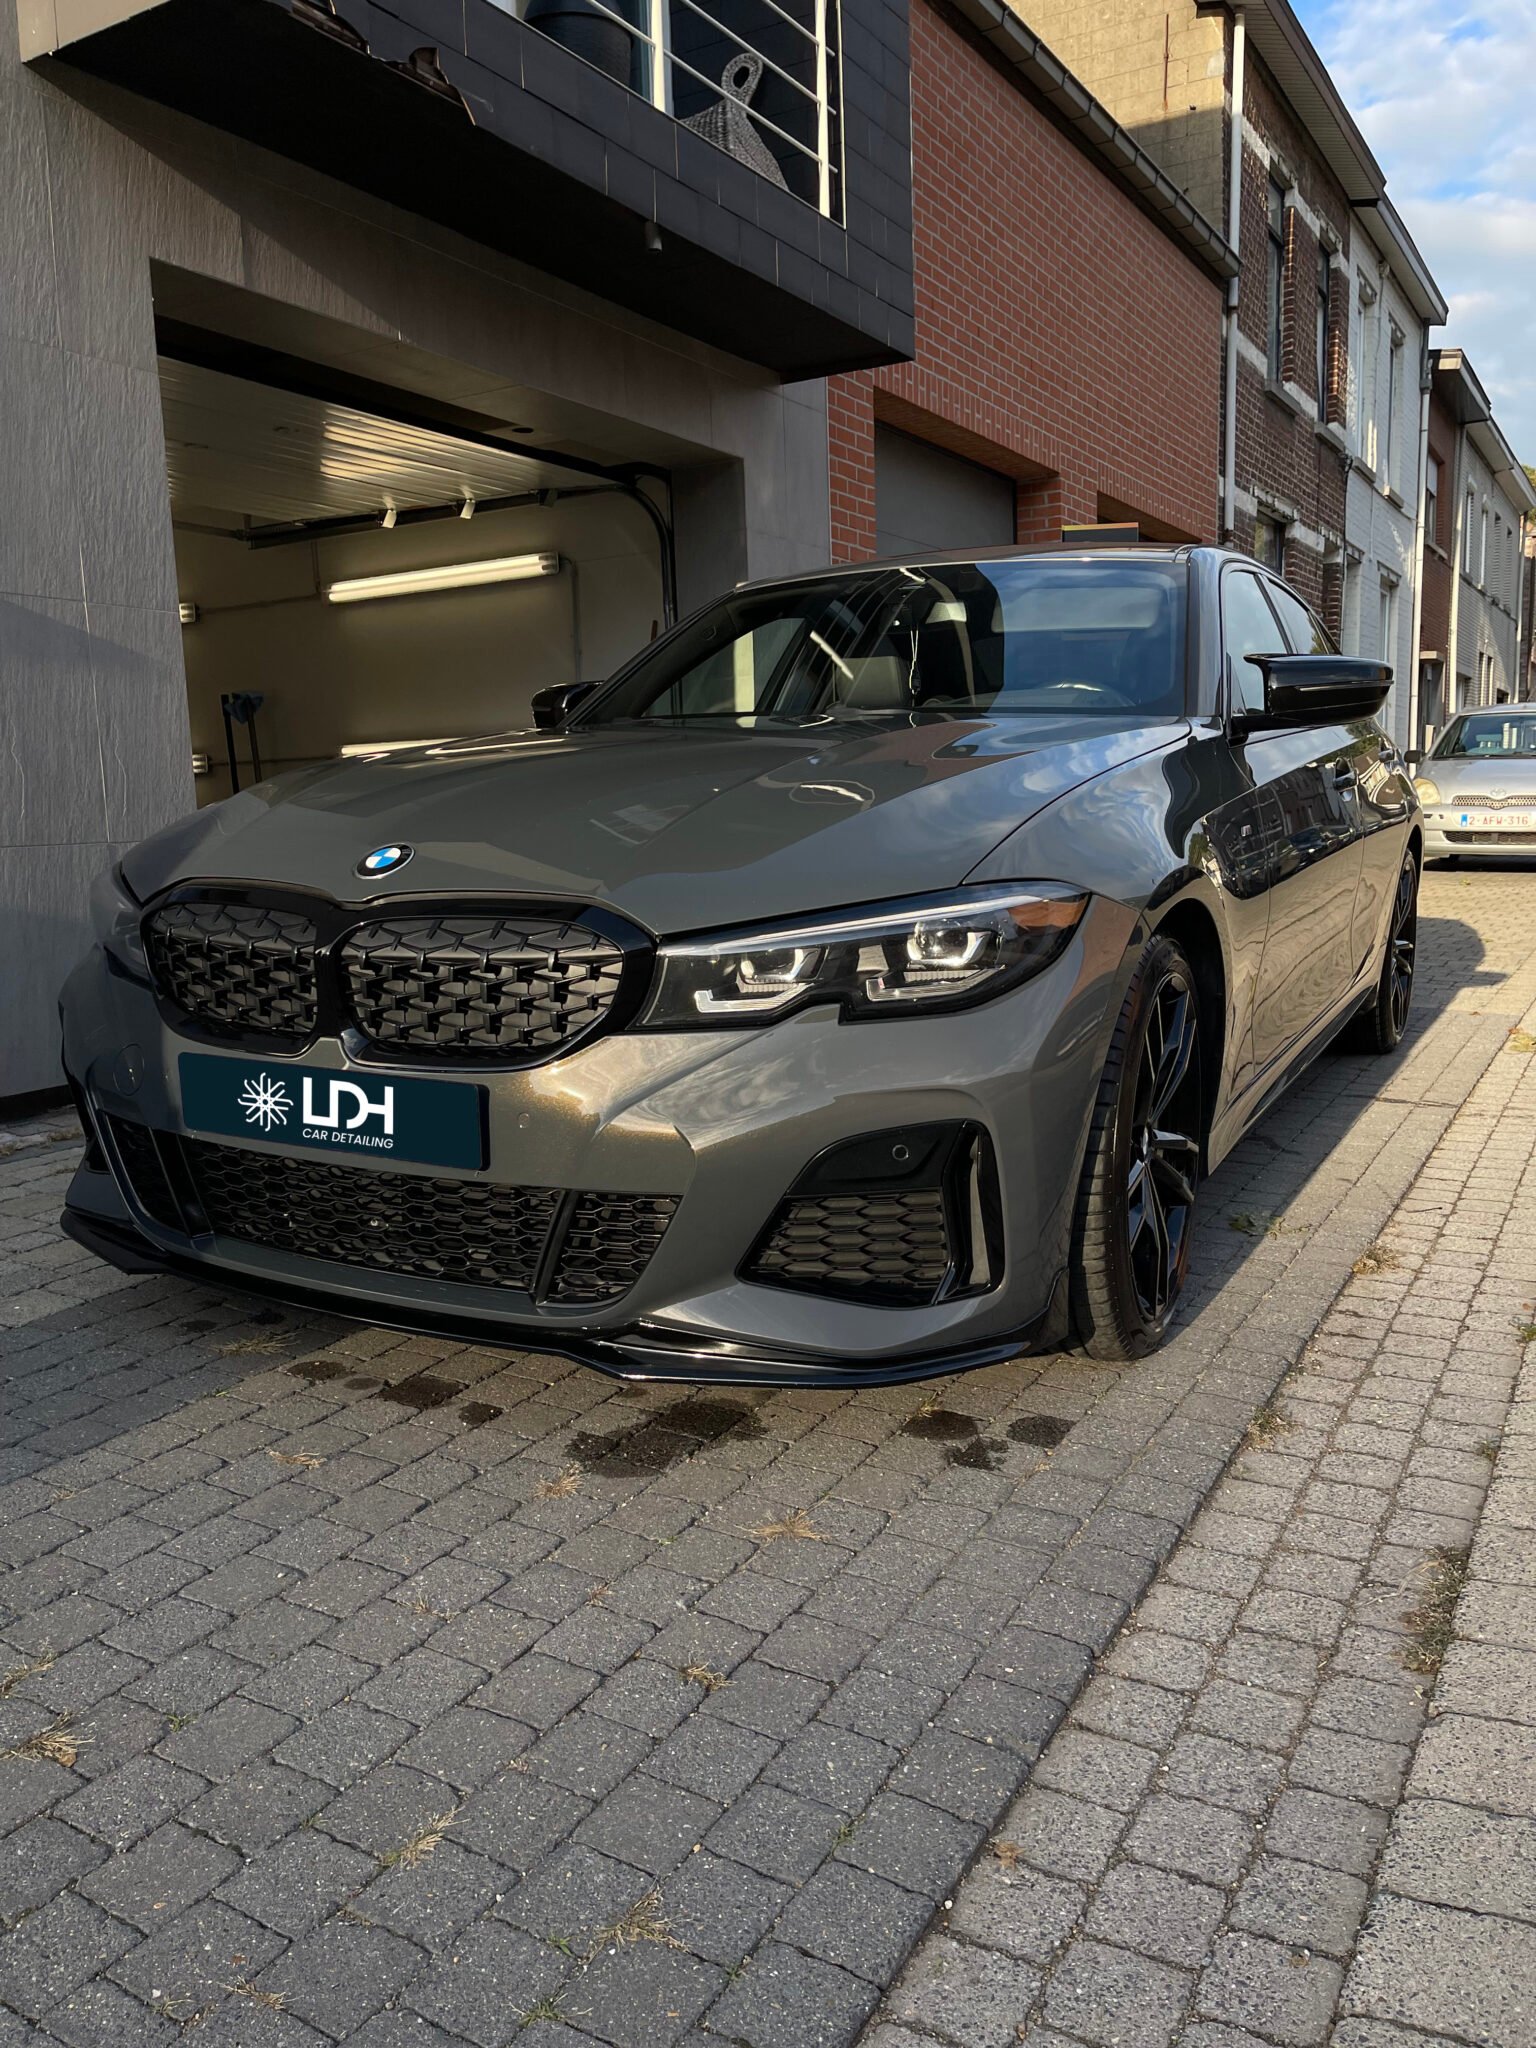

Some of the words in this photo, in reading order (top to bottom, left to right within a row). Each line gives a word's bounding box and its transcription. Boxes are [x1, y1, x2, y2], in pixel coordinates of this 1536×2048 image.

[302, 1076, 394, 1135] LDH
[302, 1128, 328, 1141] CAR
[331, 1131, 394, 1149] DETAILING
